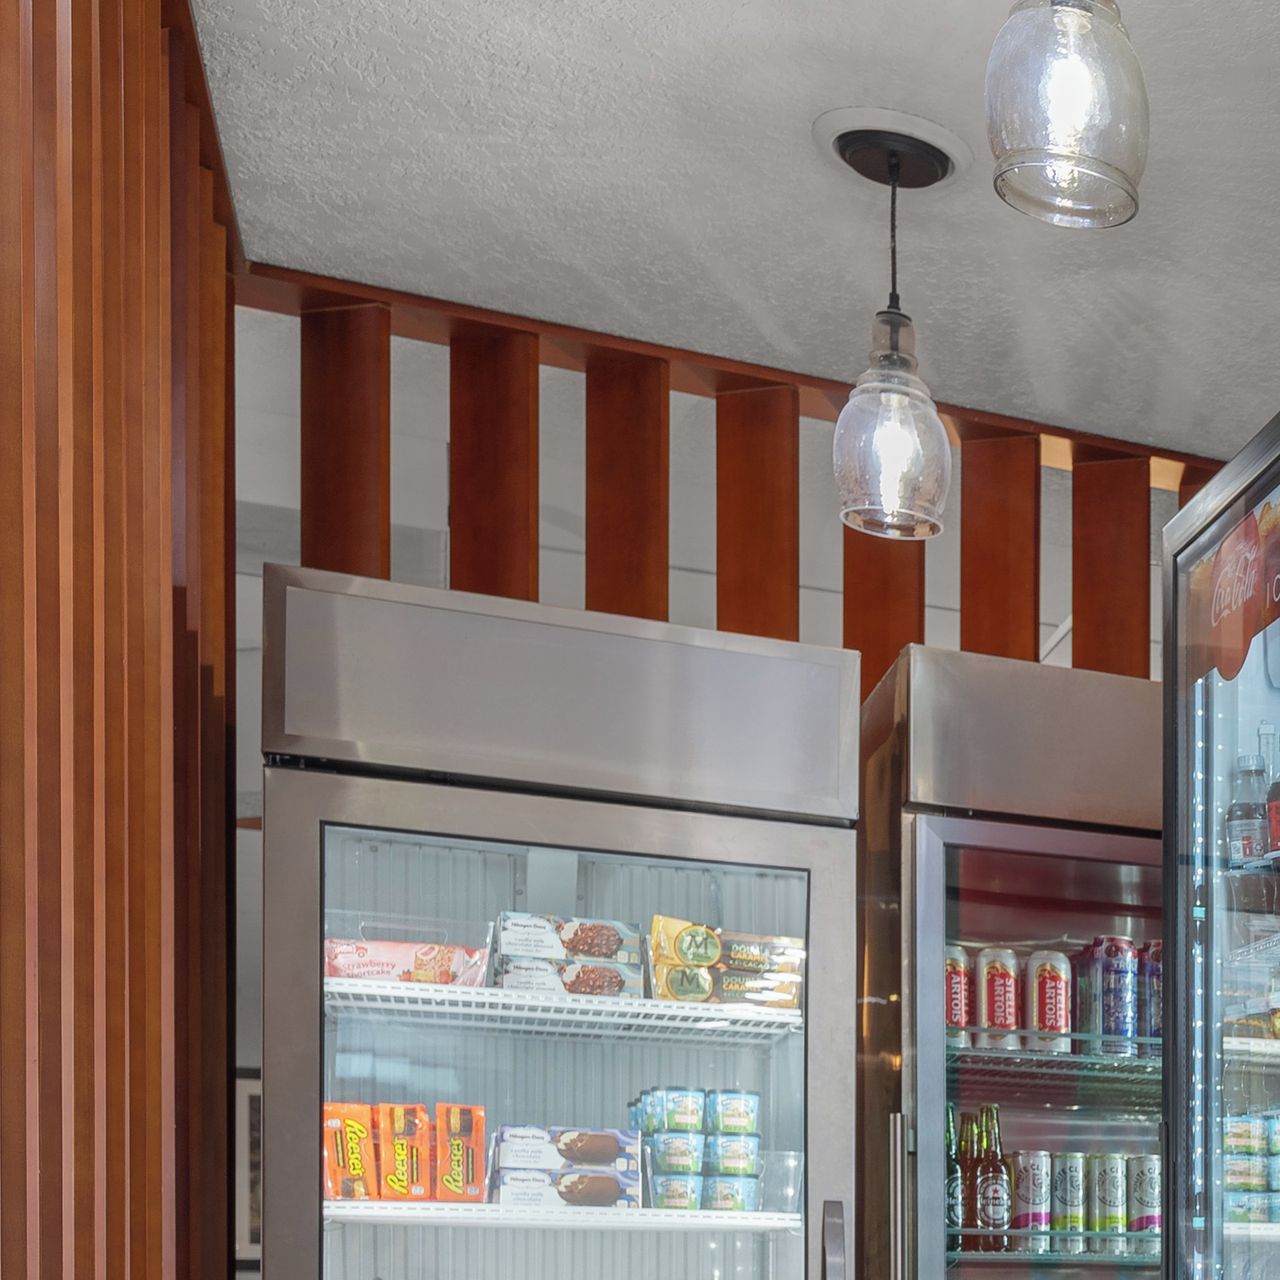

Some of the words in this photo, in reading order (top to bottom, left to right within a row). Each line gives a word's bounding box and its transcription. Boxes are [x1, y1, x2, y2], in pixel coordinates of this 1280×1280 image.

[951, 974, 961, 1022] ARTOIS
[994, 976, 1005, 1025] ARTOIS
[1006, 977, 1016, 1025] STELLA
[1045, 979, 1056, 1026] ARTOIS
[1056, 980, 1065, 1027] STELLA
